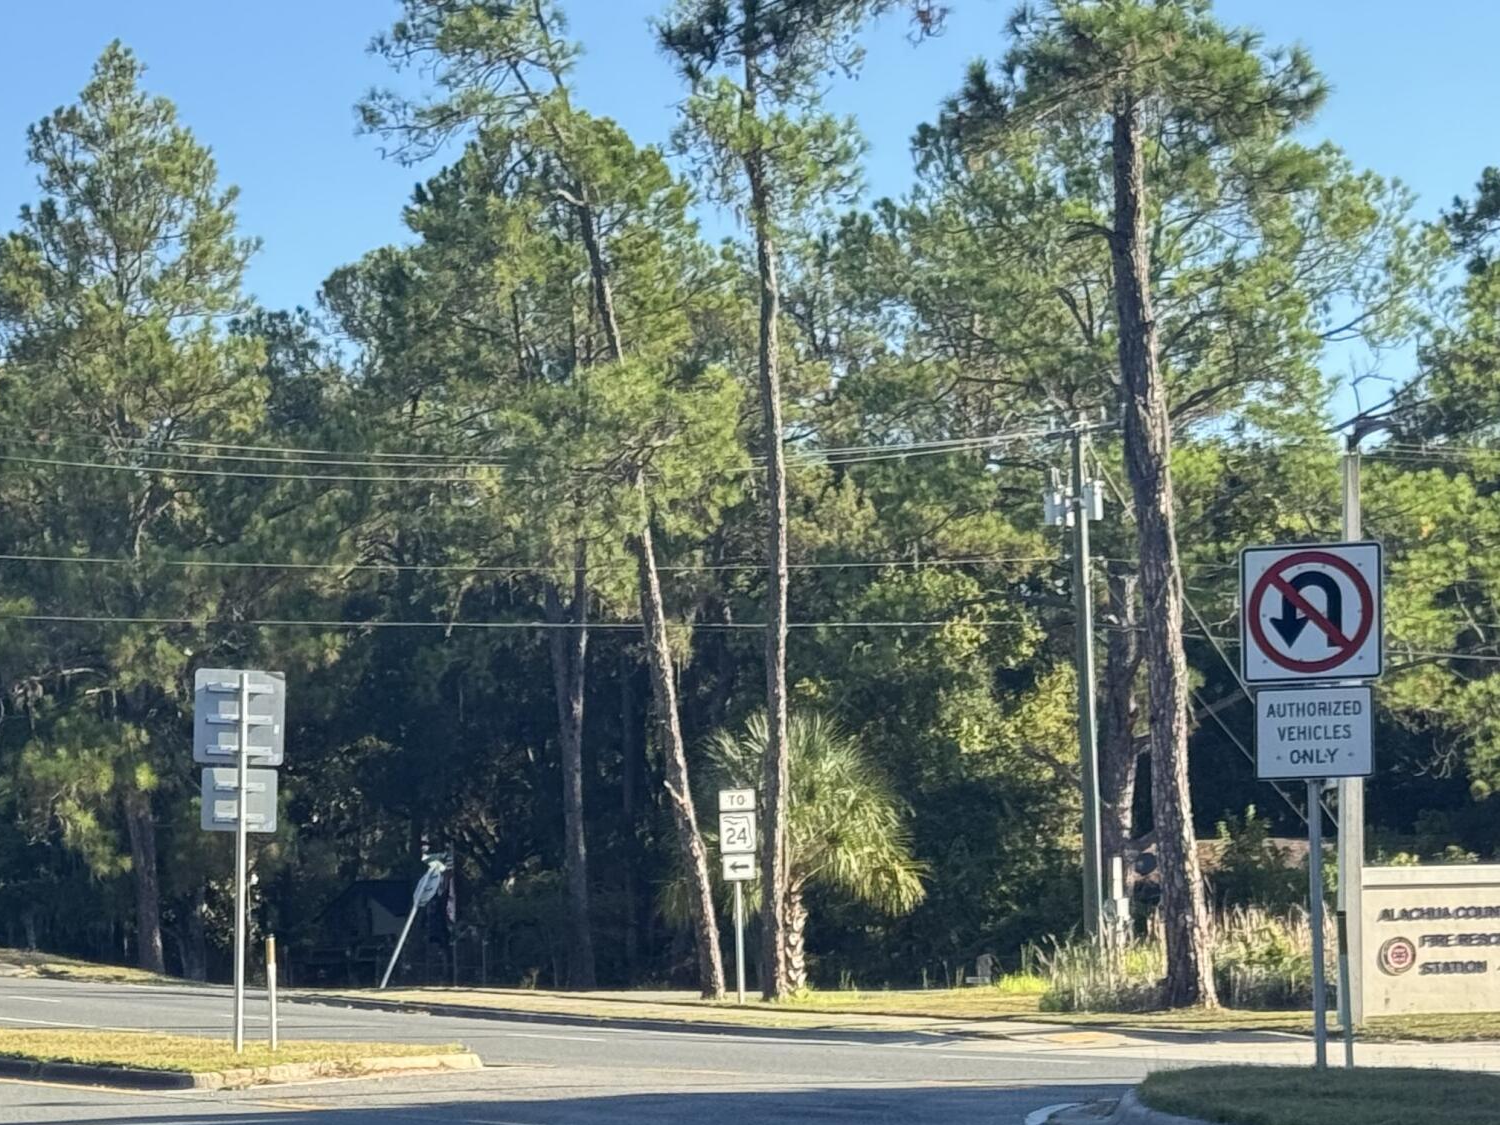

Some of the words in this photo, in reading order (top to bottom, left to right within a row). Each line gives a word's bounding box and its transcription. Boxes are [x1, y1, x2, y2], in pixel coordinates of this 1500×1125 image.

[1266, 700, 1362, 718] AUTHORIZED
[1277, 724, 1352, 741] VEHICLES
[1289, 748, 1339, 764] ONLY
[728, 795, 745, 806] TO
[726, 827, 747, 845] 24
[1419, 933, 1454, 948] FIRE
[1419, 961, 1487, 976] STATION
